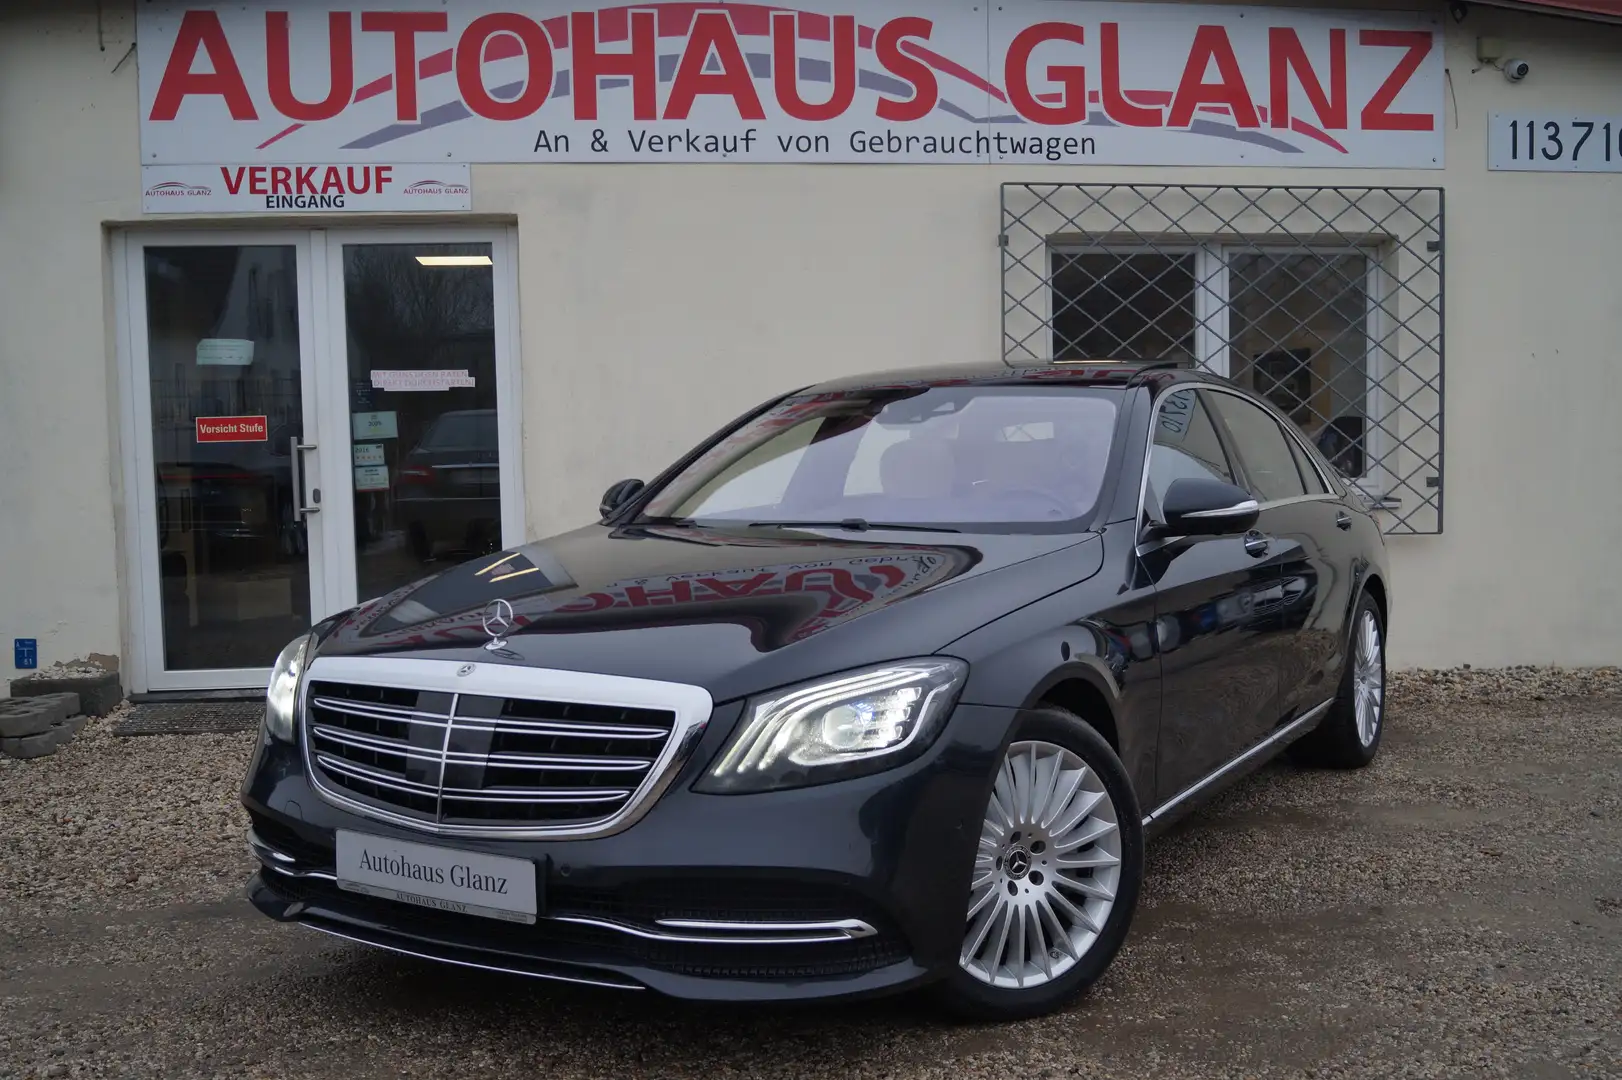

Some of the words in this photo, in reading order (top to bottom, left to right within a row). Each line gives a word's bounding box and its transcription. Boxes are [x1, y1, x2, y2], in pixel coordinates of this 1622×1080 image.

[149, 9, 939, 122] AUTOHAUS
[1004, 22, 1435, 132] GLANZ
[534, 130, 570, 153] An
[591, 130, 609, 153] &
[628, 129, 757, 154] Verkauf
[778, 136, 830, 154] von
[849, 130, 1096, 161] Gebrauchtwagen
[1509, 120, 1622, 162] 11371
[220, 166, 393, 195] VERKAUF
[266, 194, 345, 209] EINGANG
[199, 424, 237, 434] Vorsicht
[239, 423, 264, 433] Stufe
[359, 848, 445, 884] Autohaus
[450, 863, 508, 895] Glanz
[396, 892, 437, 907] AUTOHAUS
[439, 901, 468, 913] GLANZ
